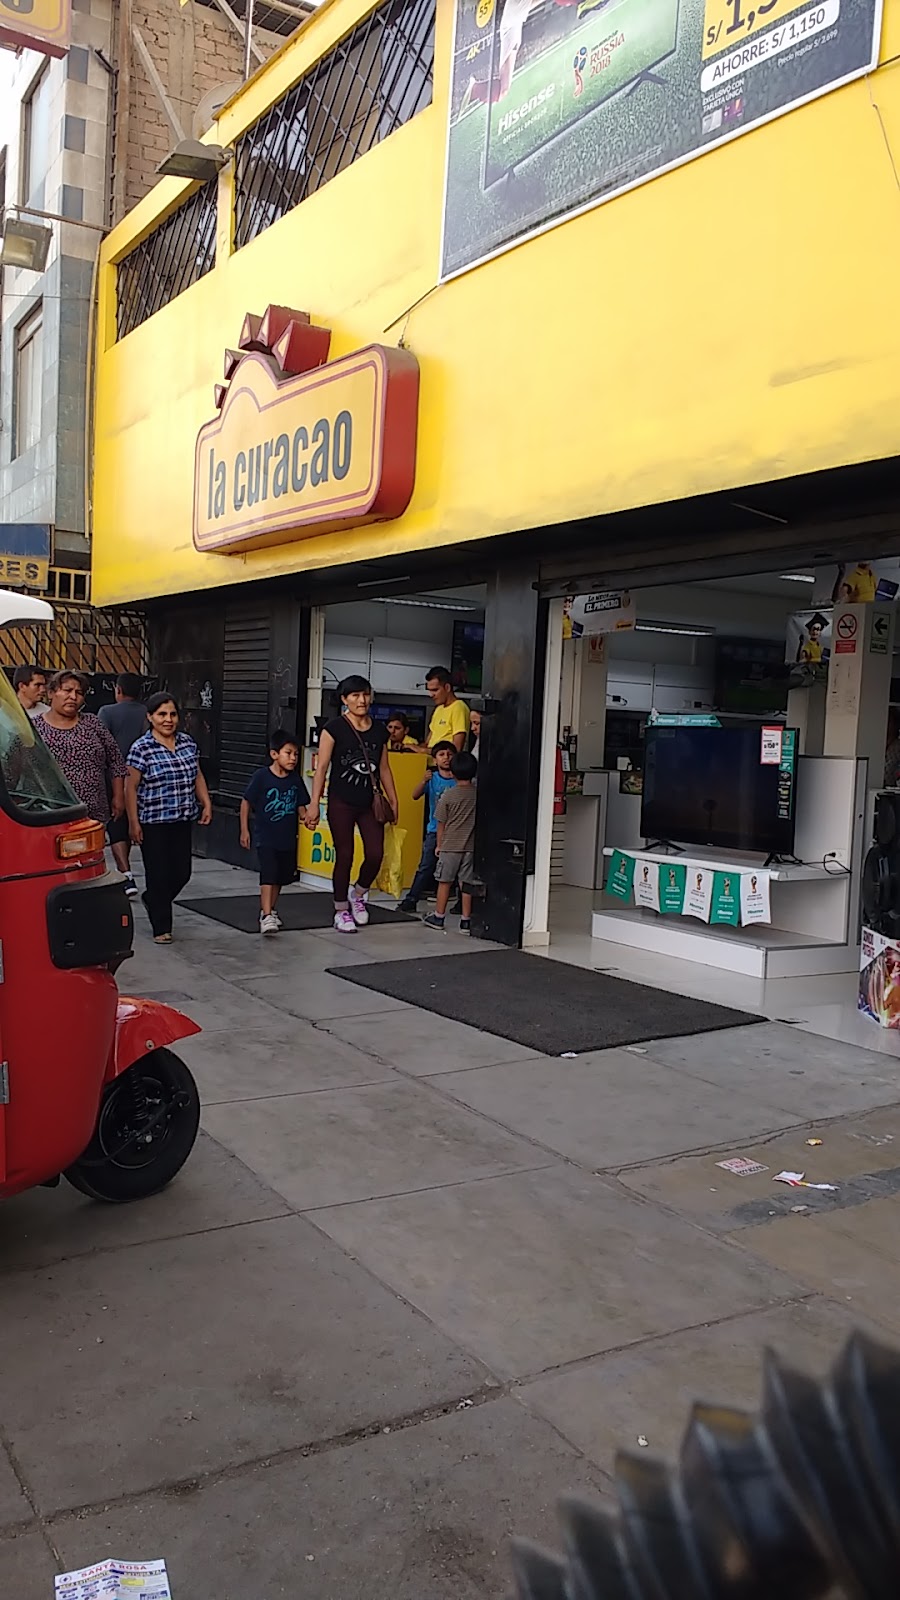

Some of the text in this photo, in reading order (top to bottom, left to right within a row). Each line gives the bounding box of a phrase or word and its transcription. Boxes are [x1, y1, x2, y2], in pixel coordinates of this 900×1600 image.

[706, 20, 723, 46] S/
[712, 8, 826, 81] AHORRE: S/ 1,150
[590, 33, 625, 65] RUSSIA
[590, 55, 611, 78] 2018
[732, 77, 745, 90] CON
[497, 82, 556, 136] Hisense
[207, 410, 353, 521] la curacao
[81, 1561, 116, 1577] SANTA
